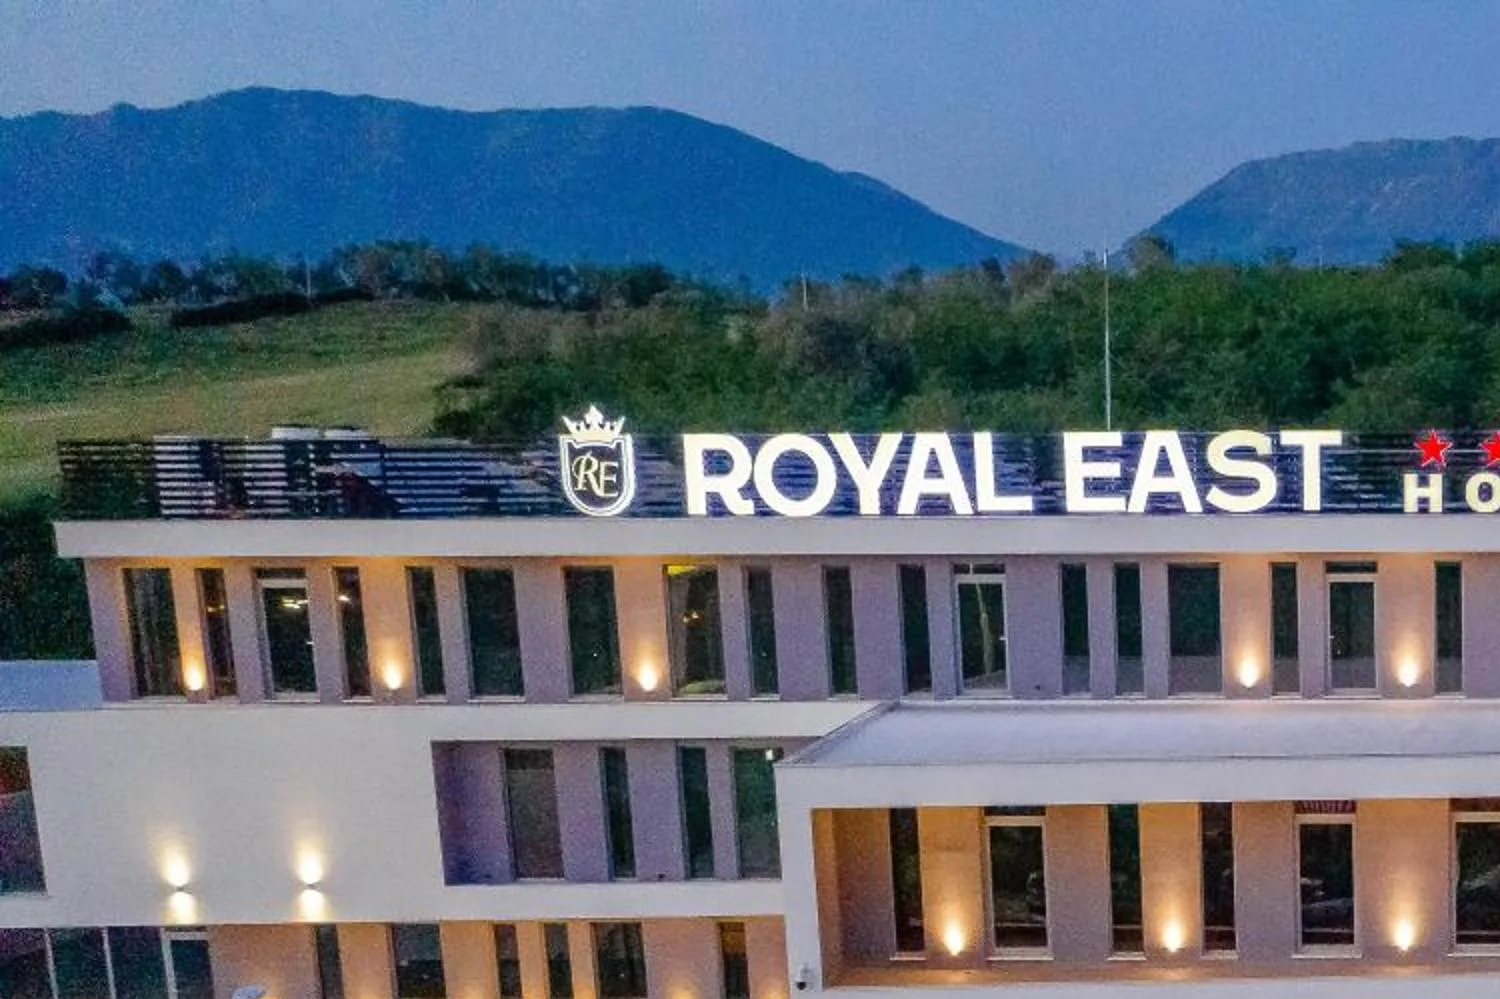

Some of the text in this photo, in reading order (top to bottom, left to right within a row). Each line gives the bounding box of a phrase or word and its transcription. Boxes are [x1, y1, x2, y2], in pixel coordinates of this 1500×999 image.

[571, 450, 620, 498] RE
[682, 430, 1342, 516] ROYAL EAST
